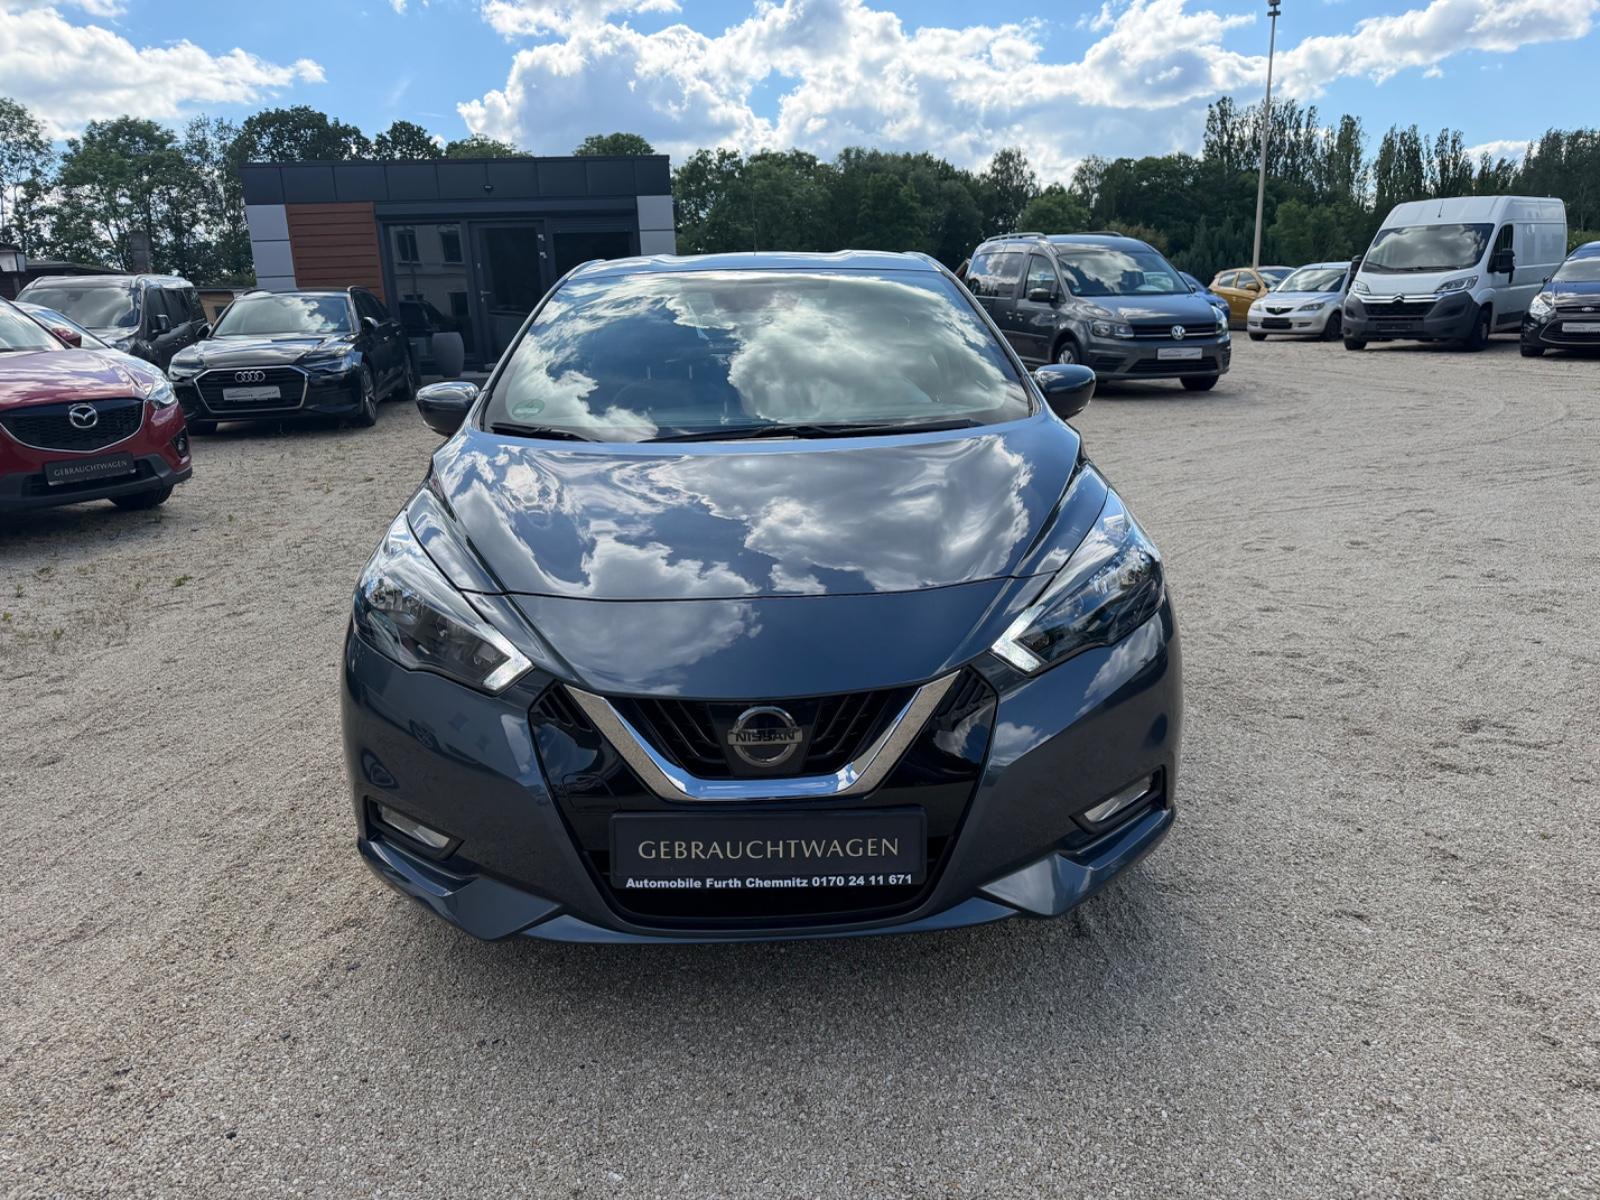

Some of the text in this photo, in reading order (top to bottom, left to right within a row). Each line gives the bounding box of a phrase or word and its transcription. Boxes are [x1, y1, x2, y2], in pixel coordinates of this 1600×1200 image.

[53, 460, 128, 477] GEBRAUCHTWAGEN
[735, 728, 795, 742] NISSAN
[638, 838, 899, 860] GEBRAUCHTWAGEN
[625, 873, 912, 889] Automobile Furth Chemnitz 0170 24 11 671
